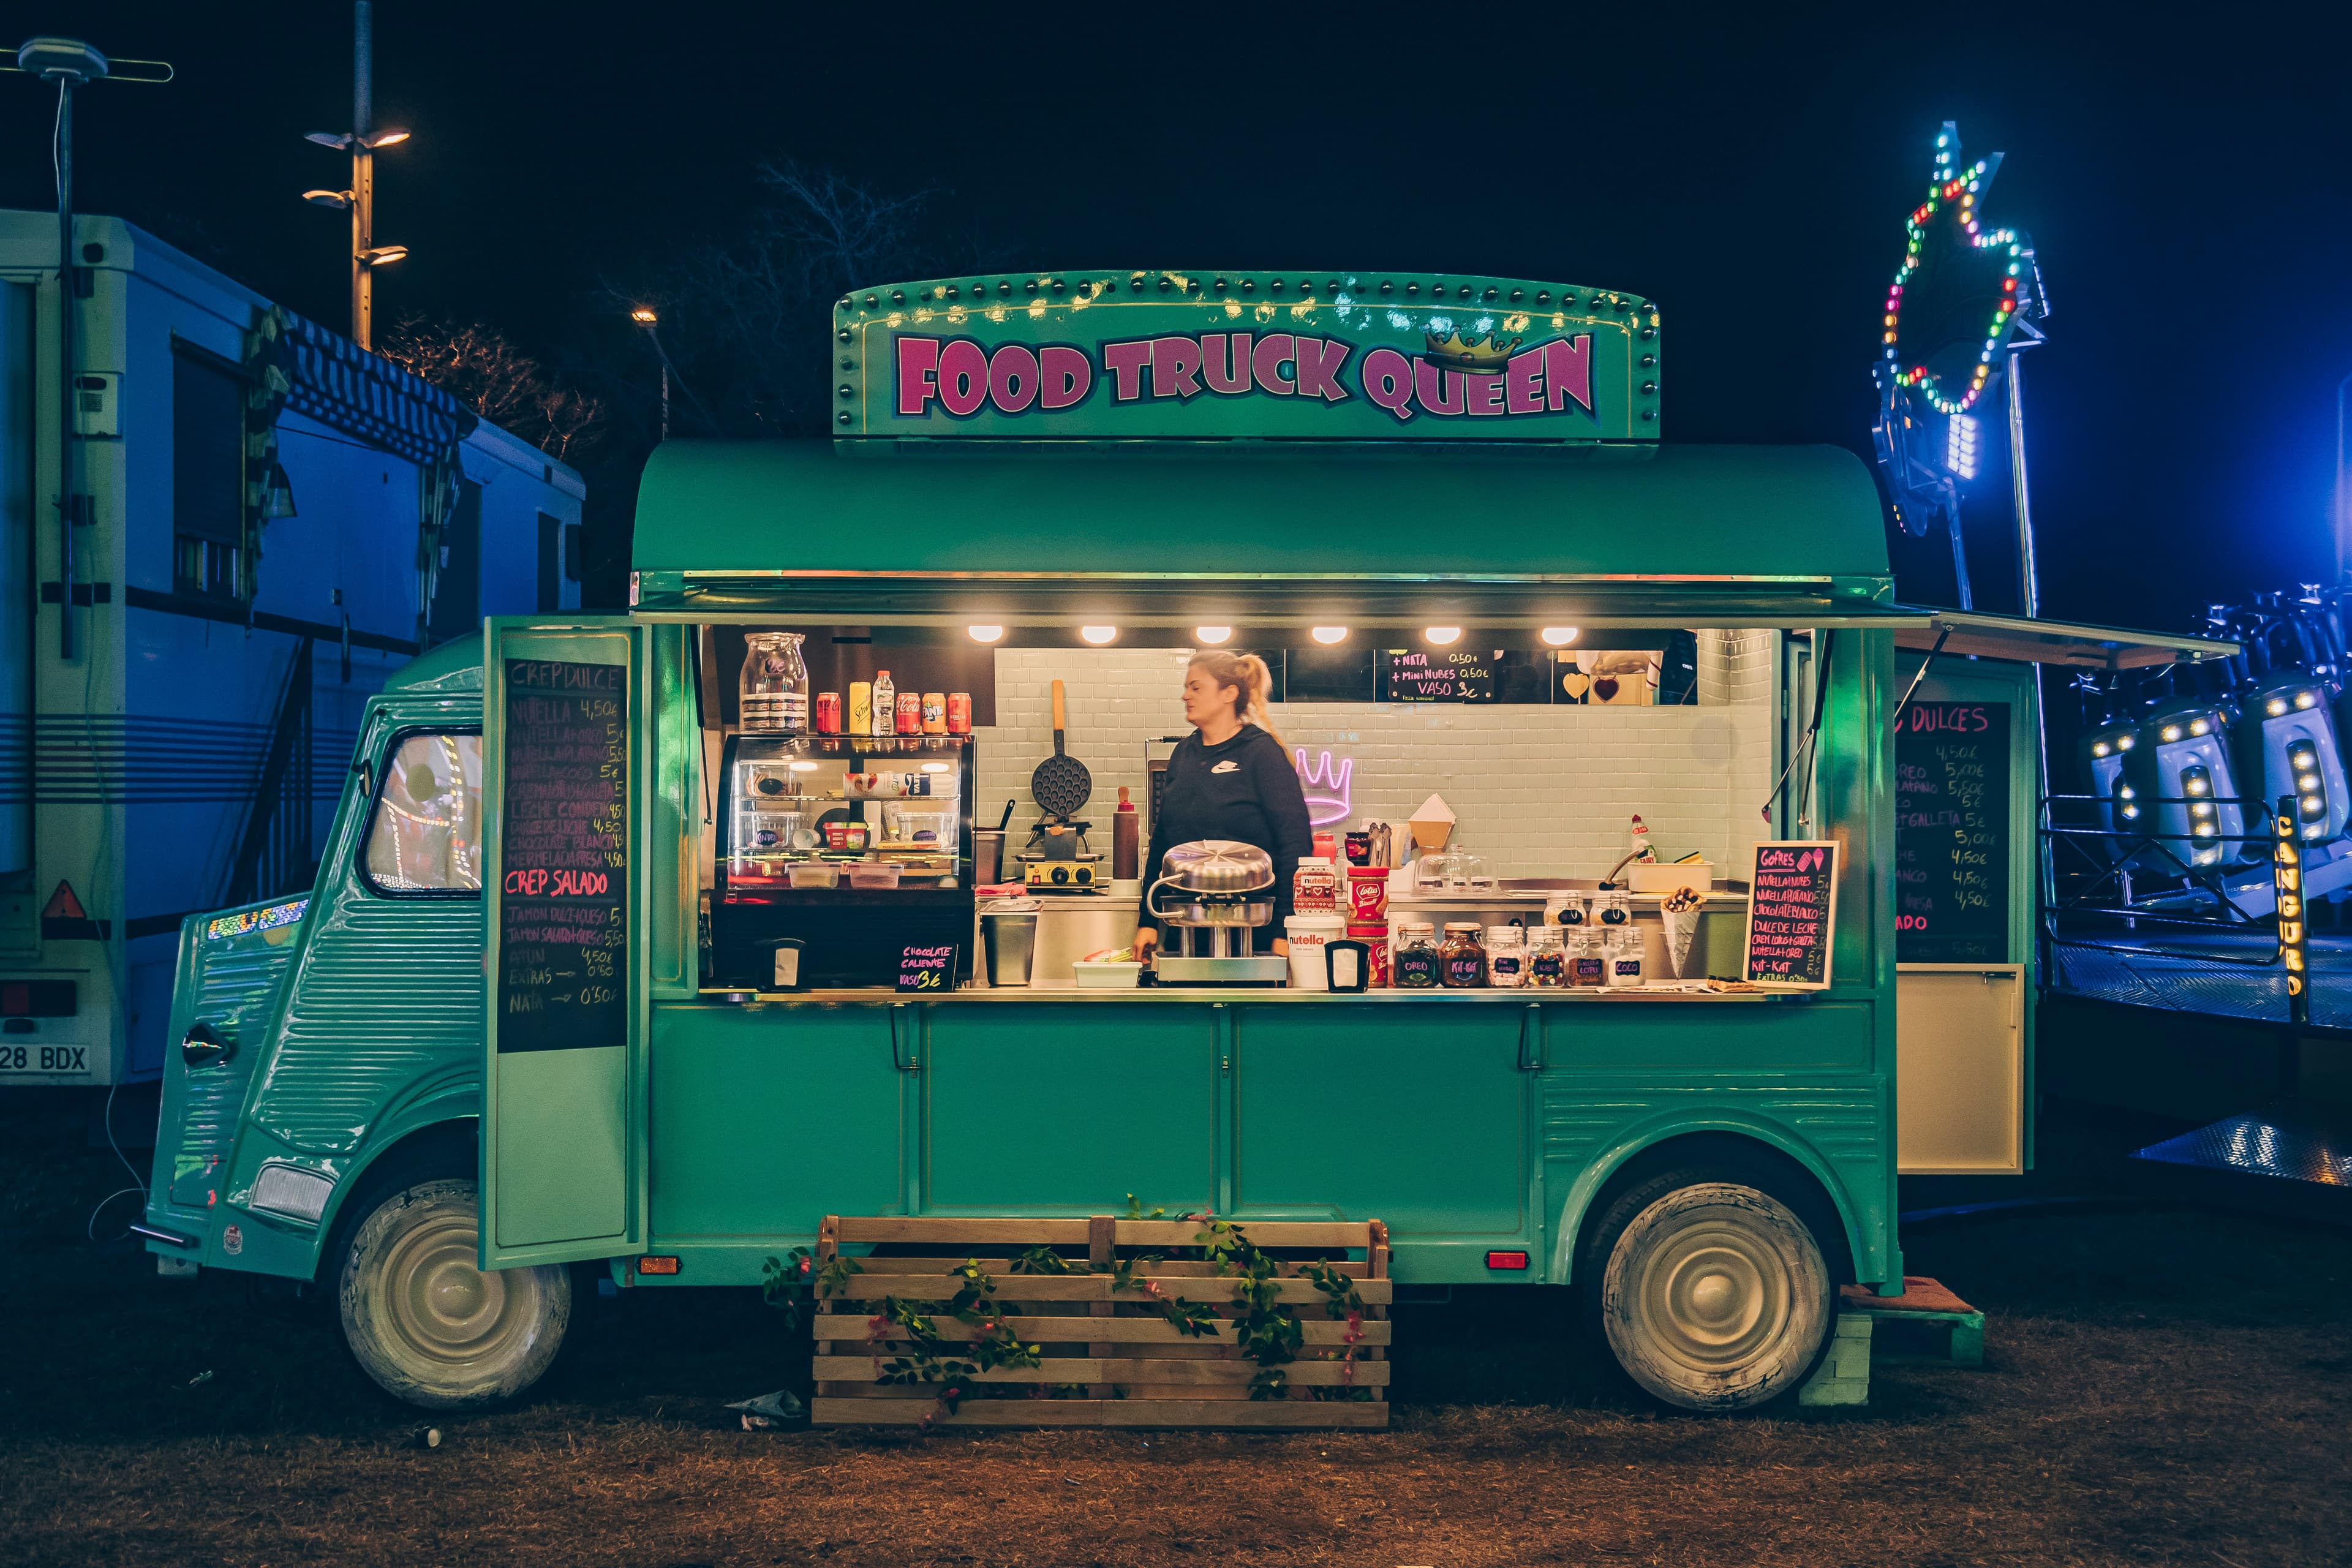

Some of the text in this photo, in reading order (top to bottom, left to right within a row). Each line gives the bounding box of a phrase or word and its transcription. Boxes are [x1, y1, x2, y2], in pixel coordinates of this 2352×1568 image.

[896, 331, 1594, 421] FOOD TRUCK QUEEN
[1402, 654, 1428, 666] NATA
[1417, 682, 1451, 696] VASO
[1912, 705, 1989, 733] DULCES
[505, 869, 608, 897] CREP SALADO
[1360, 886, 1378, 895] Lotus
[1289, 934, 1324, 944] nutella
[903, 946, 952, 957] CHOCOLATE
[1404, 961, 1428, 971] OREO
[1616, 962, 1638, 972] COCO
[900, 974, 919, 986] VASO
[40, 1046, 85, 1069] BDX
